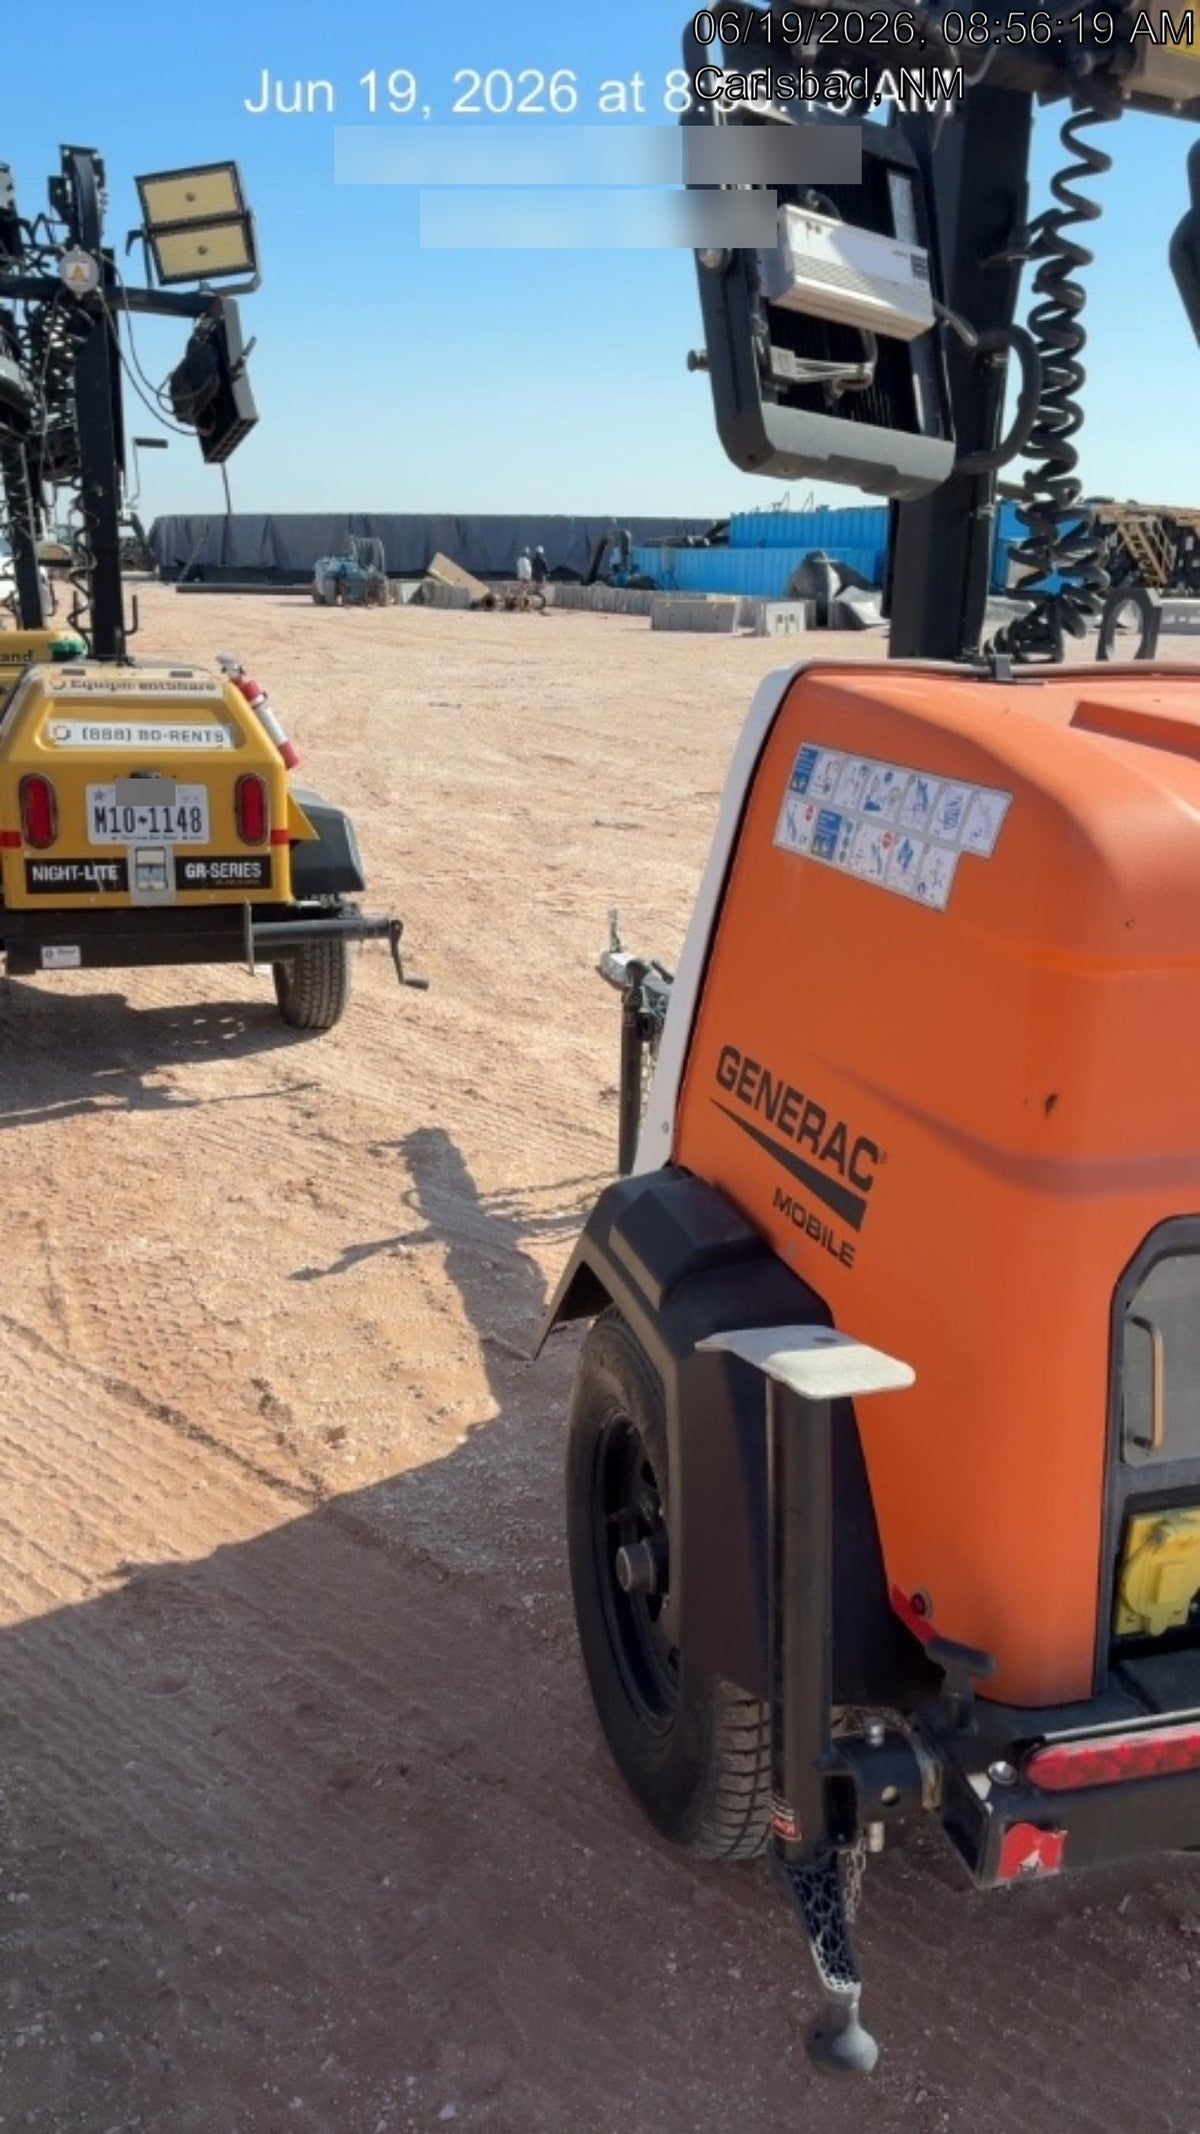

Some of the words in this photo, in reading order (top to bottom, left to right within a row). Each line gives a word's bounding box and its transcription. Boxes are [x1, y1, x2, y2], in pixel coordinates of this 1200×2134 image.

[32, 864, 118, 882] NIGHT-LITE
[184, 862, 262, 880] GR-SERIES
[715, 1045, 879, 1193] GENERAC
[772, 1187, 856, 1270] MOBILE
